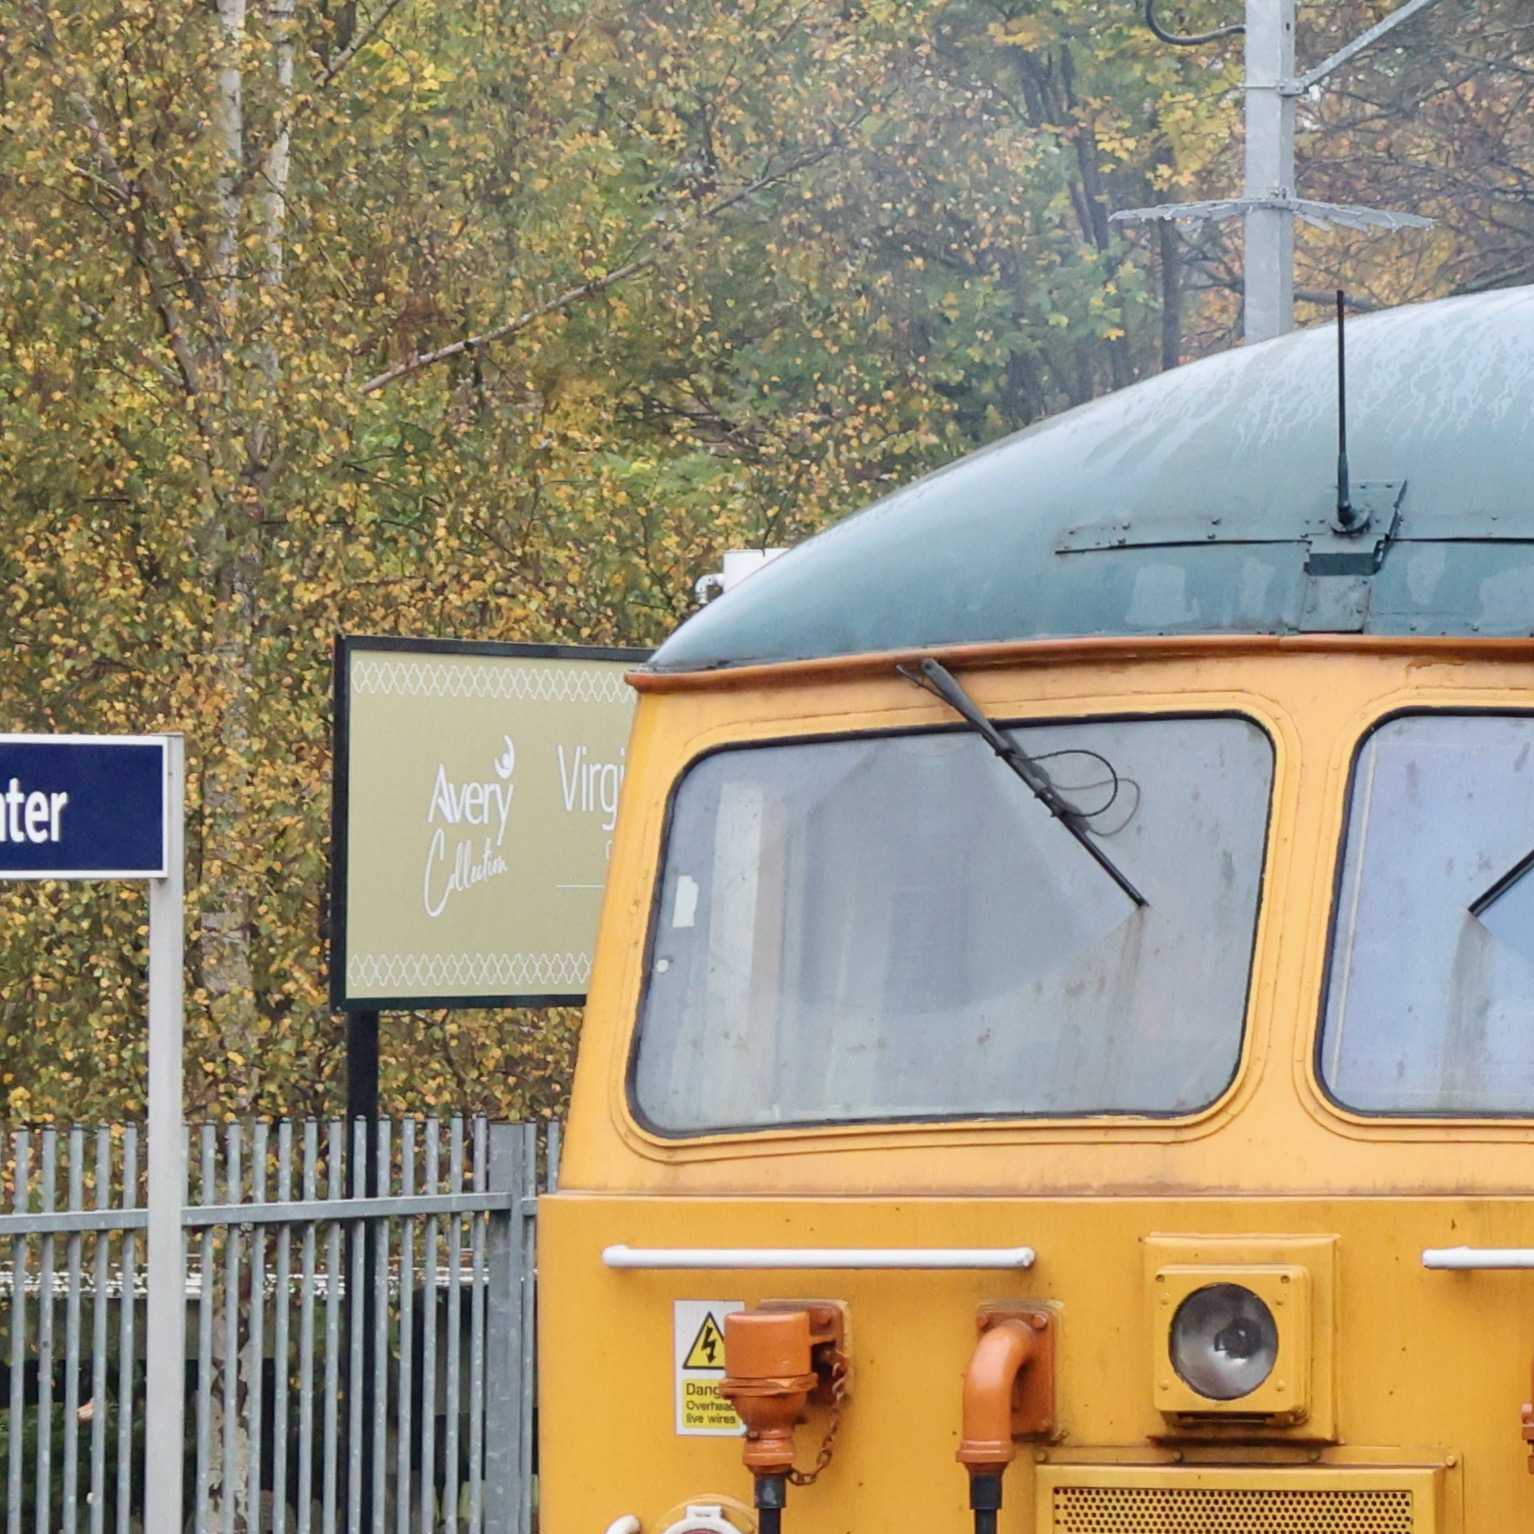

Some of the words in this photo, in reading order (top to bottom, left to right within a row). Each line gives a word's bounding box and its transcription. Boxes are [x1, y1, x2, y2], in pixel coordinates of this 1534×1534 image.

[428, 762, 514, 847] Avery
[423, 828, 508, 918] Collection
[686, 1412, 704, 1424] live
[707, 1413, 736, 1424] wires
